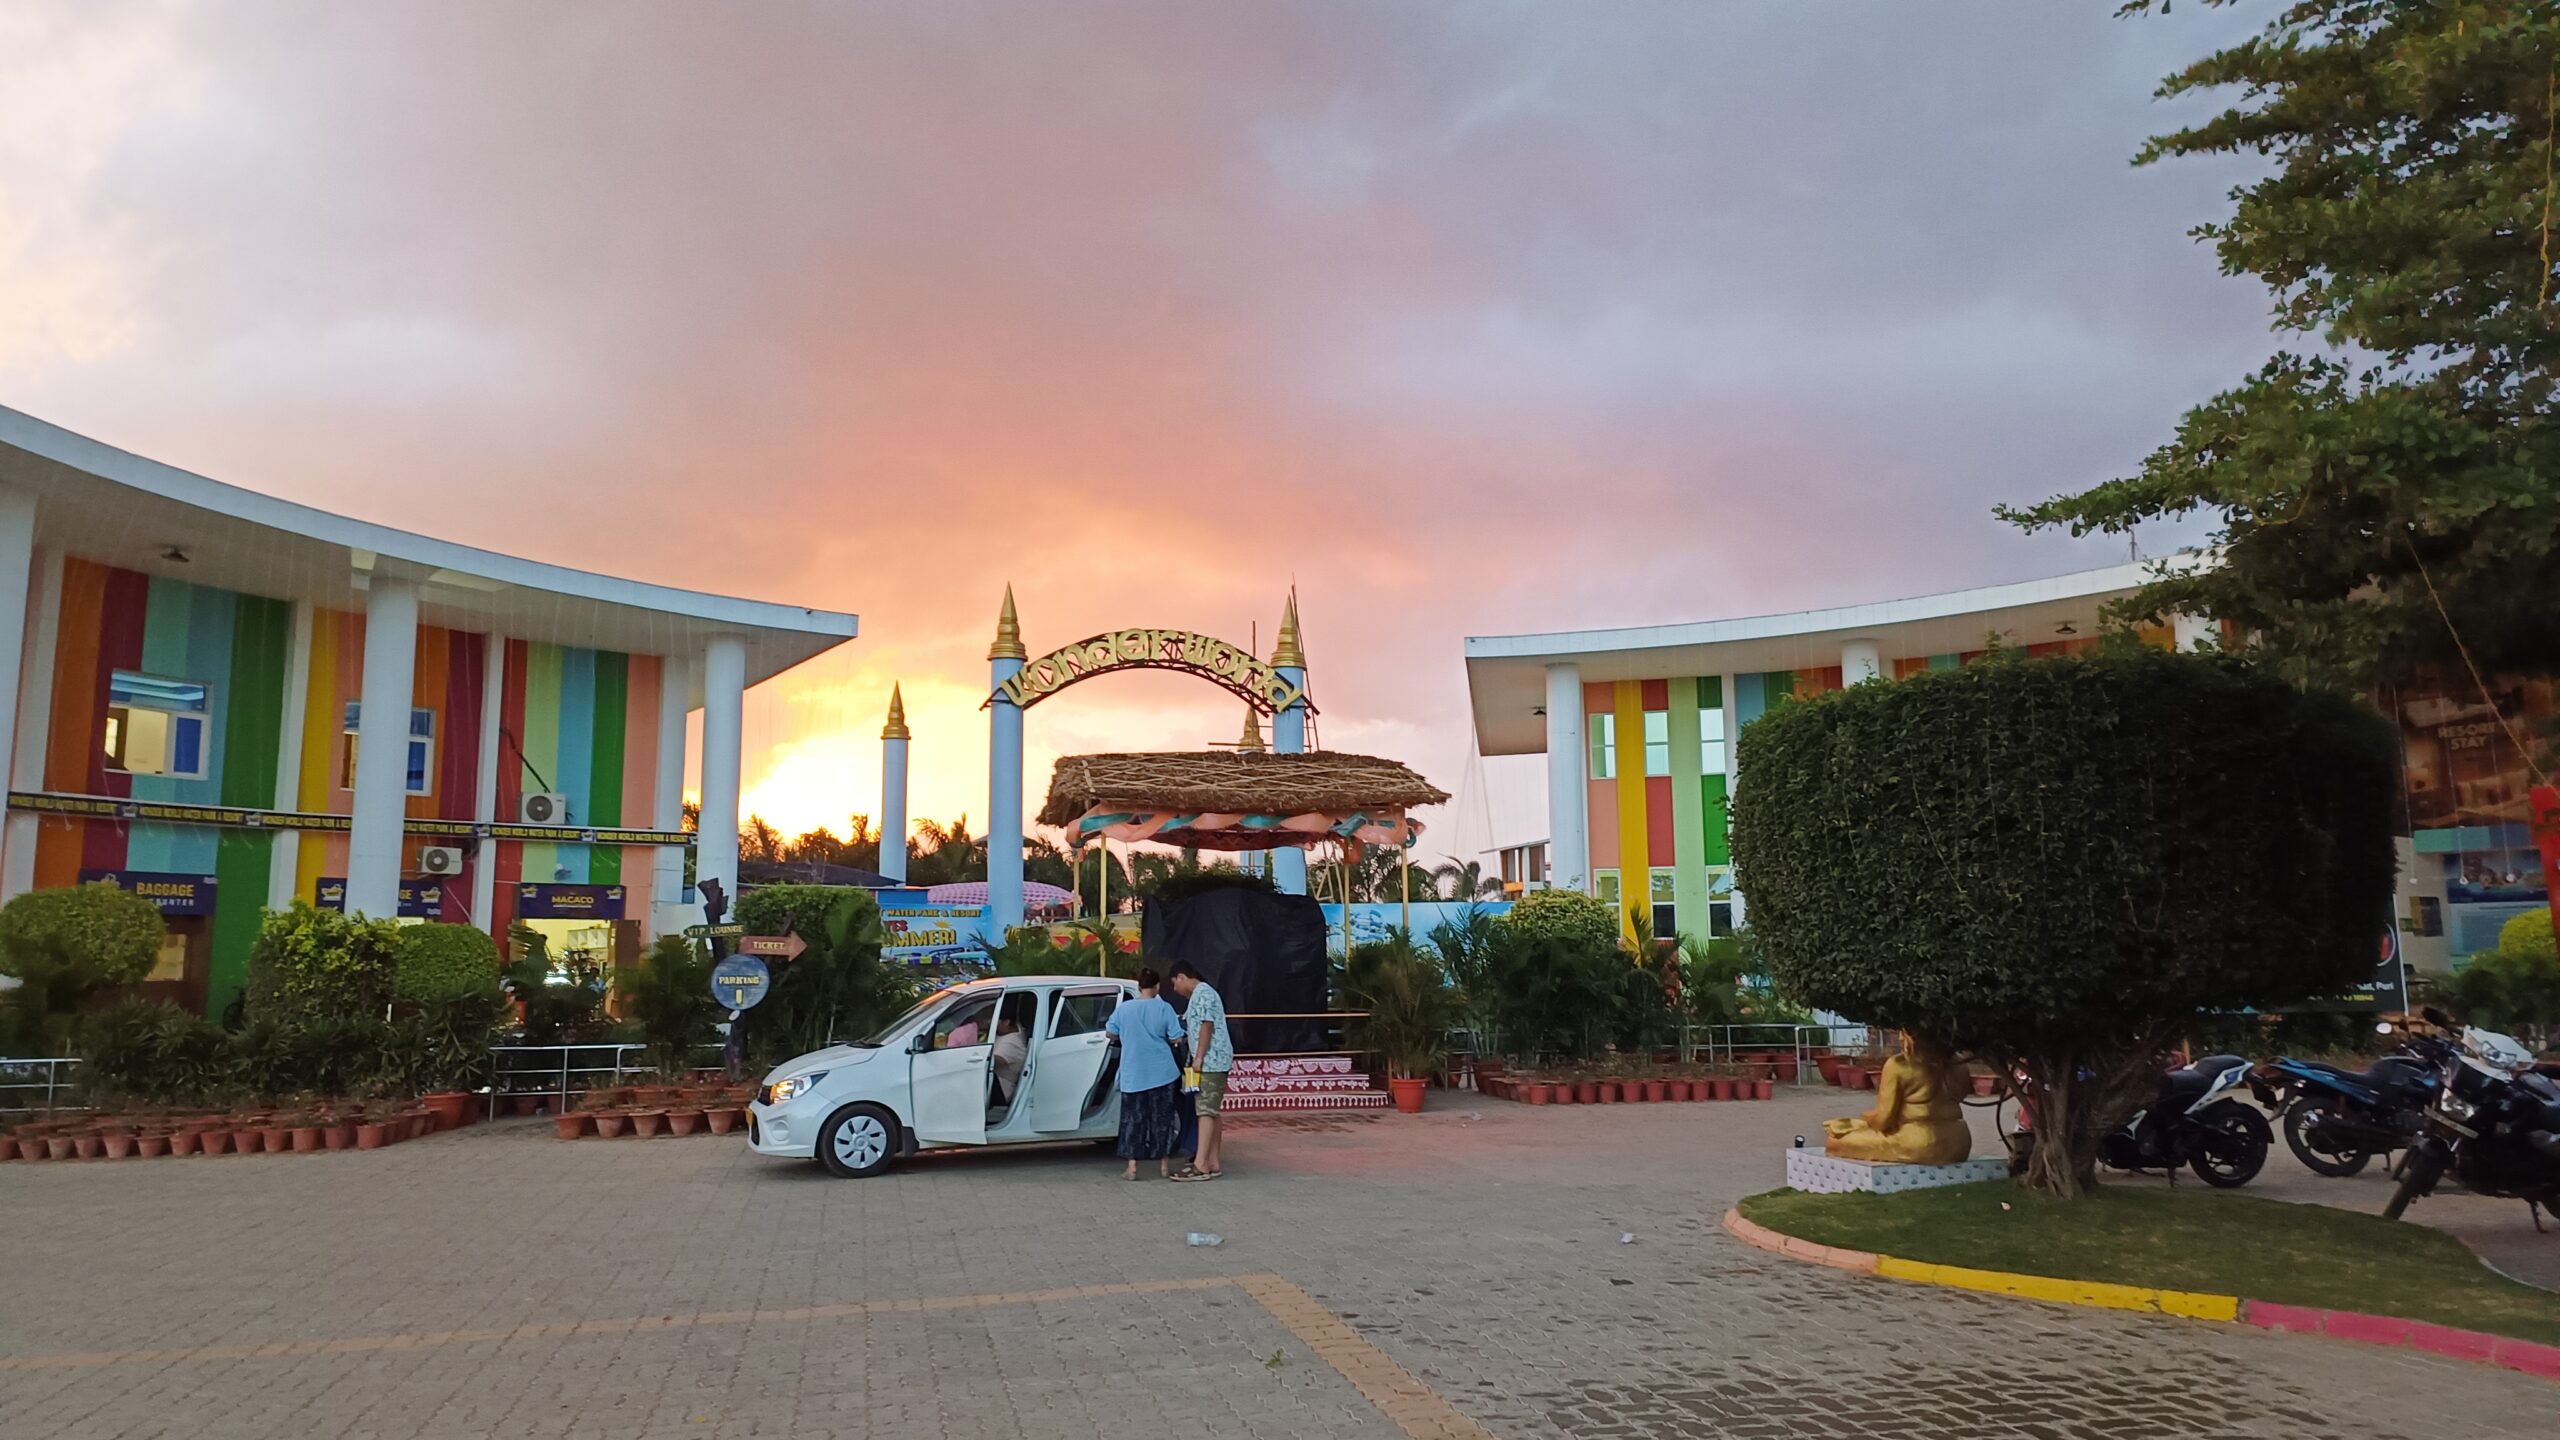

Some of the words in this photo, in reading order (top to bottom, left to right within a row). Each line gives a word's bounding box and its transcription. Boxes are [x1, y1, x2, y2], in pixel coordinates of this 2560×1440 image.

[2451, 736, 2486, 750] STAY
[136, 882, 194, 896] BAGGAGE
[552, 896, 594, 904] MACACO
[888, 909, 915, 917] WATER
[916, 909, 939, 917] PARK
[687, 927, 705, 936] VIP
[710, 925, 744, 935] LOUNGE
[753, 941, 785, 950] TICKET
[719, 976, 759, 984] PARKING
